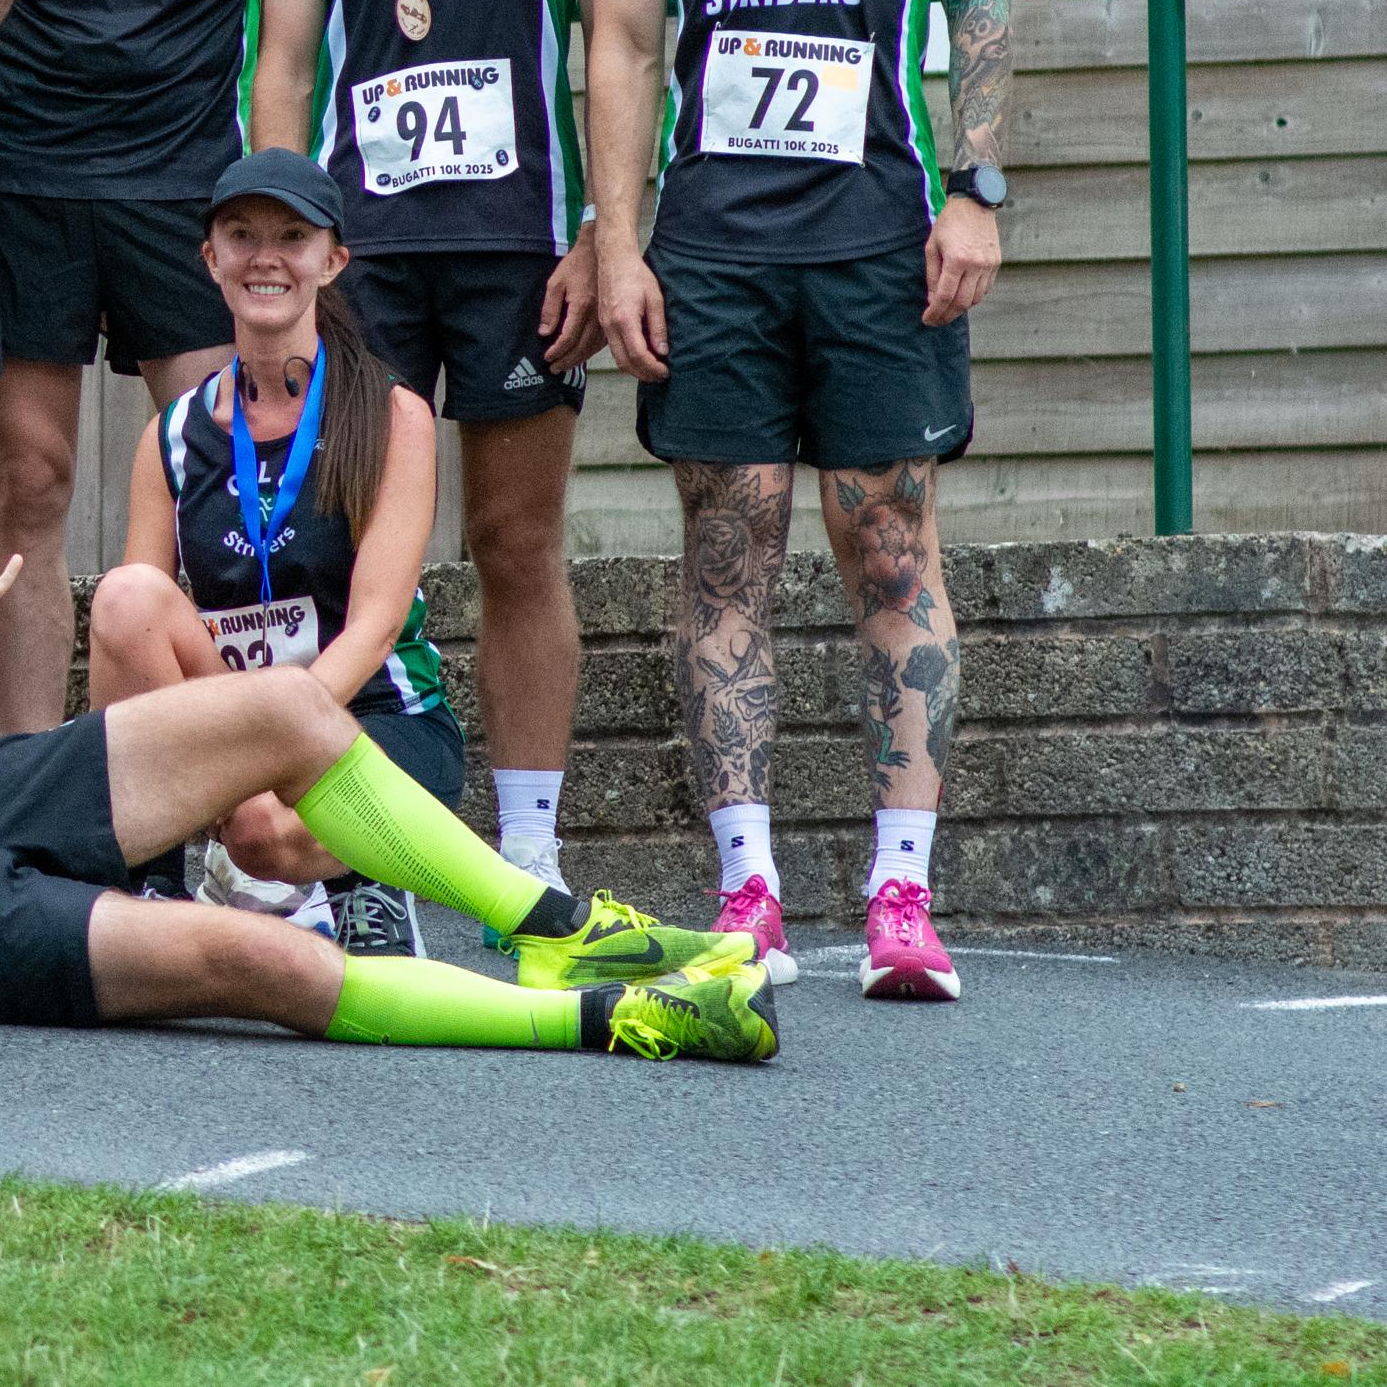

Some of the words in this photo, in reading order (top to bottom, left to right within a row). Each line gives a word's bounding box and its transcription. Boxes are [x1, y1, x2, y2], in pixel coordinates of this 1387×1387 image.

[718, 37, 741, 55] UP
[744, 38, 762, 56] &
[764, 39, 862, 65] RUNNING
[362, 83, 384, 105] UP
[386, 78, 402, 97] &
[405, 67, 499, 92] RUNNING
[748, 67, 819, 132] 72
[396, 96, 467, 162] 94
[728, 137, 780, 150] BUGATTI
[784, 140, 807, 151] 10K
[811, 142, 839, 154] 2025
[392, 165, 436, 188] BUGATTI
[440, 165, 462, 175] 10K
[466, 164, 494, 175] 2025
[504, 375, 544, 391] adidas
[223, 526, 296, 557] Striers
[220, 605, 305, 635] RUNNING
